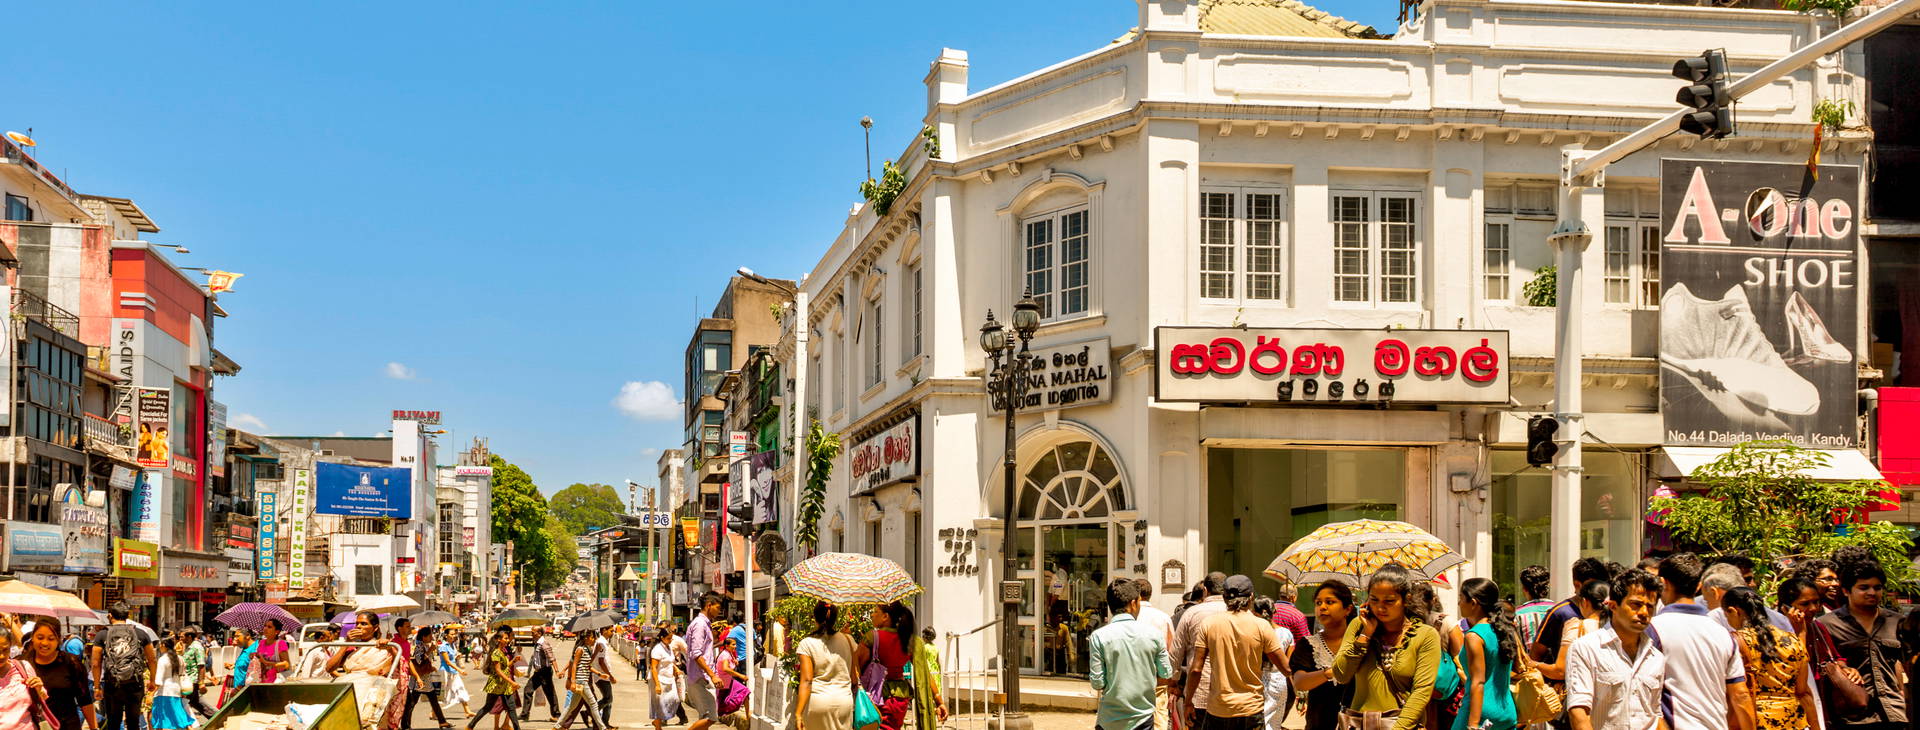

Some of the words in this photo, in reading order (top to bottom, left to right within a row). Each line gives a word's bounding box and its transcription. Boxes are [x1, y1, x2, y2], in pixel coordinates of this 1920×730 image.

[1664, 166, 1853, 244] A-One
[1743, 256, 1854, 290] SHOE
[1050, 365, 1107, 388] MAHAL
[1668, 430, 1705, 442] No.44
[1709, 431, 1753, 443] Dalada
[1811, 433, 1853, 448] Kandy.
[296, 470, 307, 514] SAREE
[290, 525, 303, 587] KINGDOM
